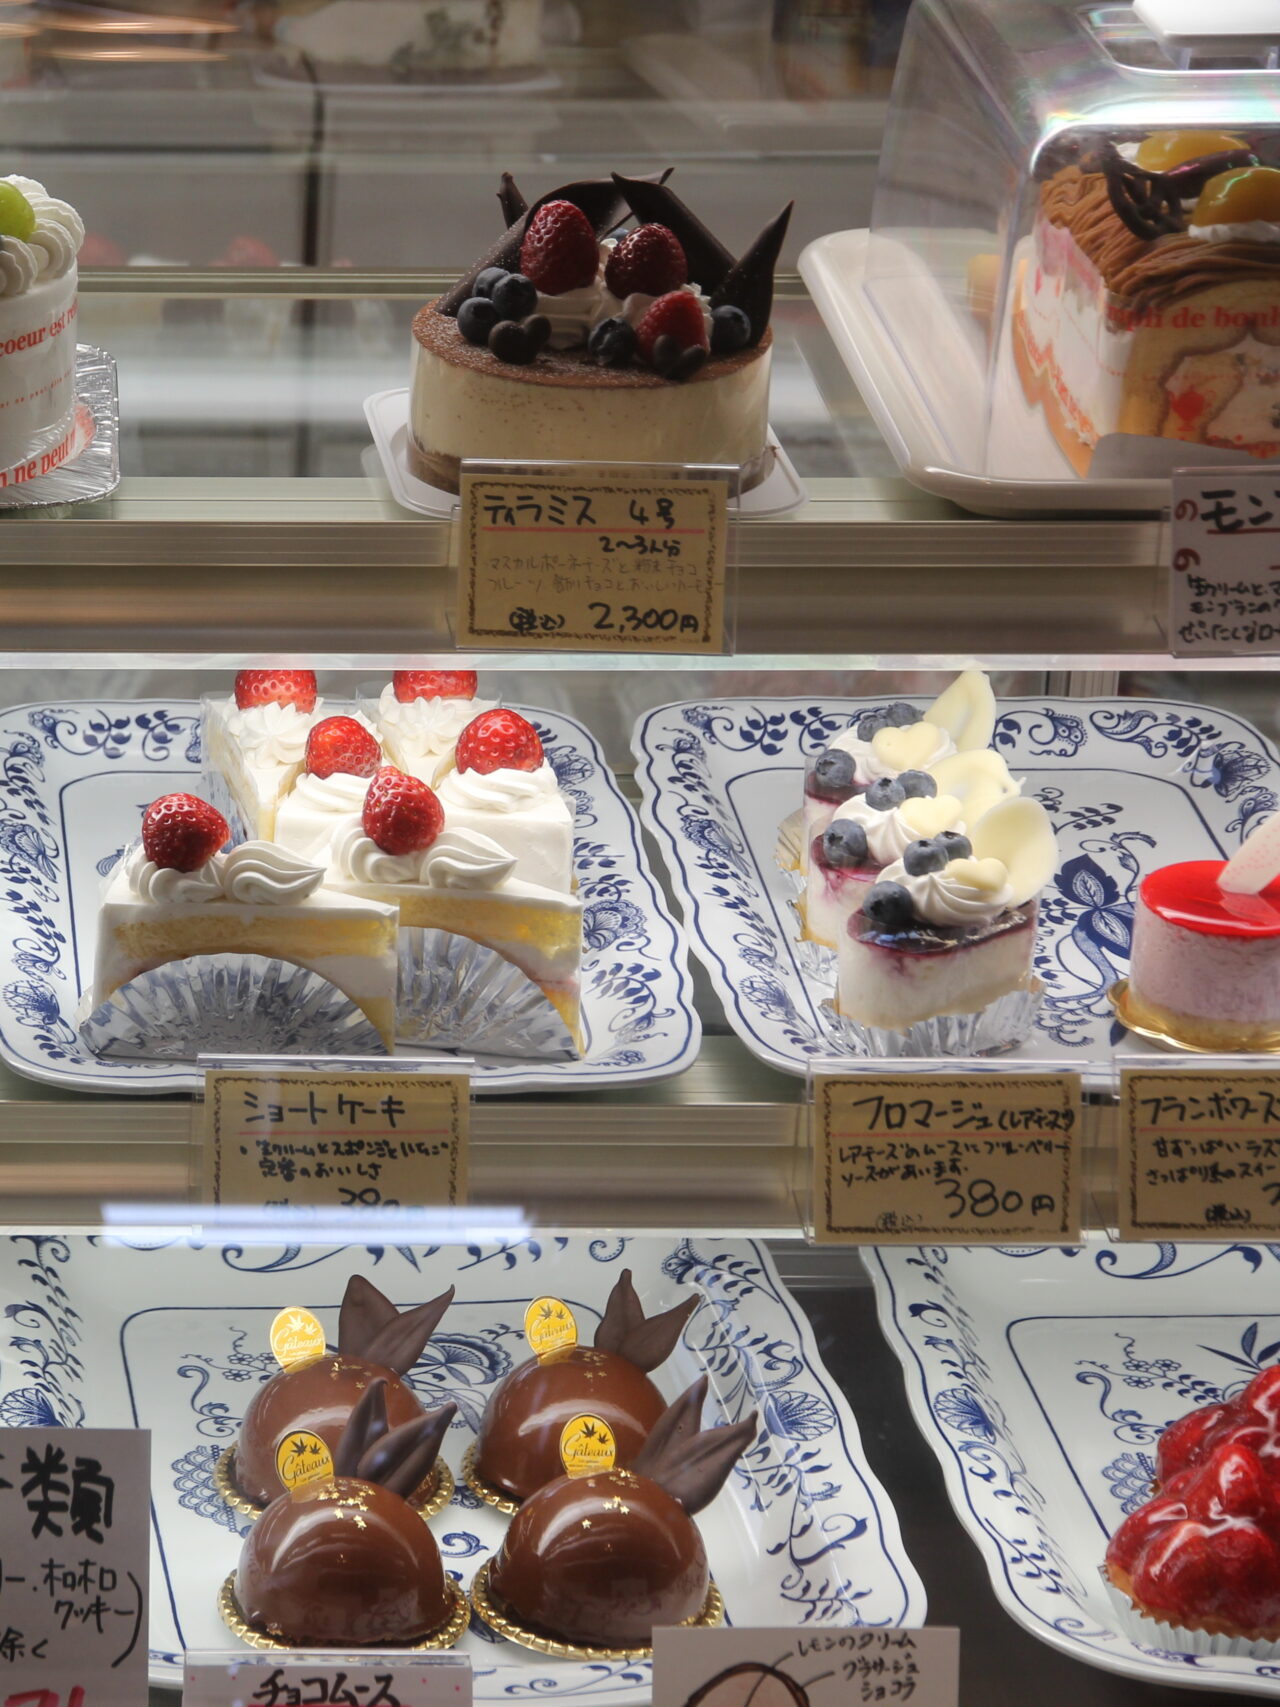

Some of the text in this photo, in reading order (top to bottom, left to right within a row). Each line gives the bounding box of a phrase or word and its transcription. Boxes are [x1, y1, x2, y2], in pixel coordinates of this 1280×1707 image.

[49, 314, 66, 338] est
[1171, 306, 1207, 329] de
[13, 459, 38, 484] ne
[40, 440, 70, 475] peut
[483, 494, 676, 530] ティラミス 4号
[588, 602, 700, 635] 2,300円
[243, 1090, 406, 1128] ショートケーキ
[934, 1177, 1056, 1220] 380円
[282, 1455, 331, 1488] Gâteaux
[796, 1631, 917, 1658] レモンのクリーム
[251, 1667, 402, 1707] チョコムース
[860, 1675, 917, 1702] ショコラ
